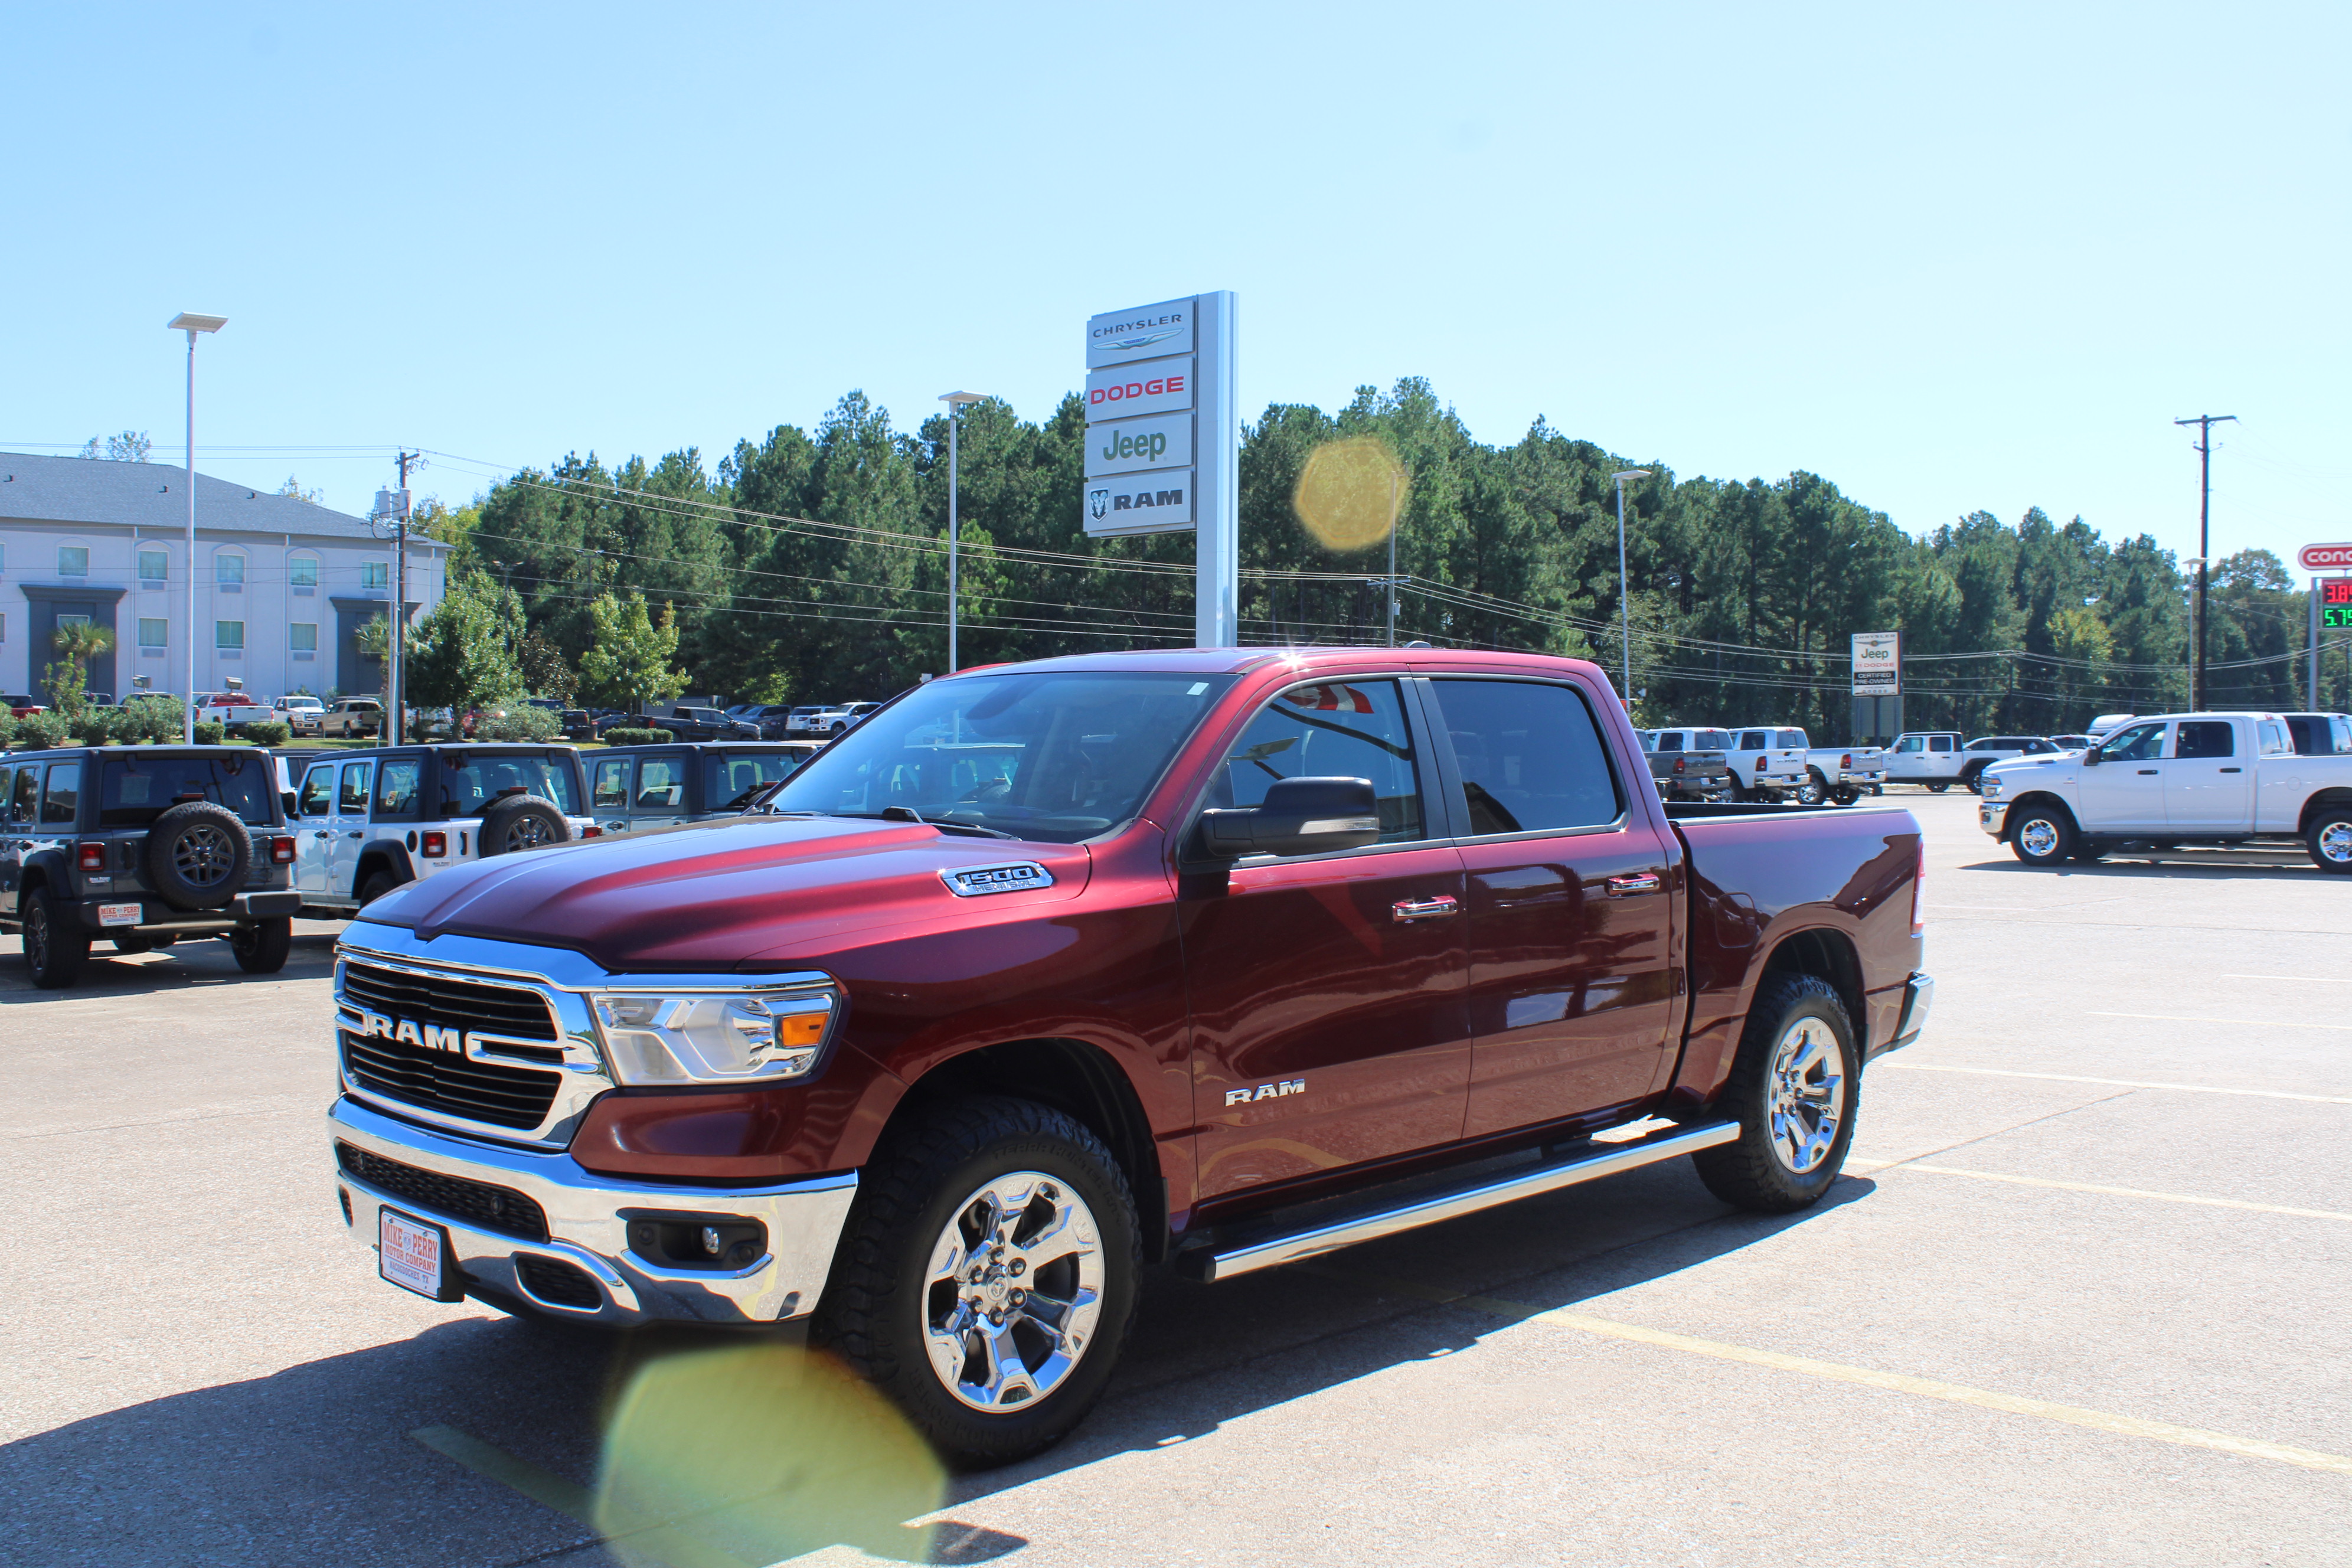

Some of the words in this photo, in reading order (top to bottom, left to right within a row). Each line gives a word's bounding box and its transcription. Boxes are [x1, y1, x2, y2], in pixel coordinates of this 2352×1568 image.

[1093, 314, 1182, 338] CHRYSLER
[1091, 376, 1184, 405] DODGE
[1103, 430, 1166, 462] Jeep
[1113, 489, 1182, 511] RAM
[1861, 648, 1889, 660] Jeep
[956, 867, 1033, 886] 1500
[367, 1012, 460, 1053] RAM
[1225, 1079, 1305, 1107] RAM
[384, 1221, 403, 1248] MIKE
[413, 1233, 438, 1261] PERRY
[385, 1243, 404, 1261] MOTOR
[406, 1252, 436, 1273] COMPANY
